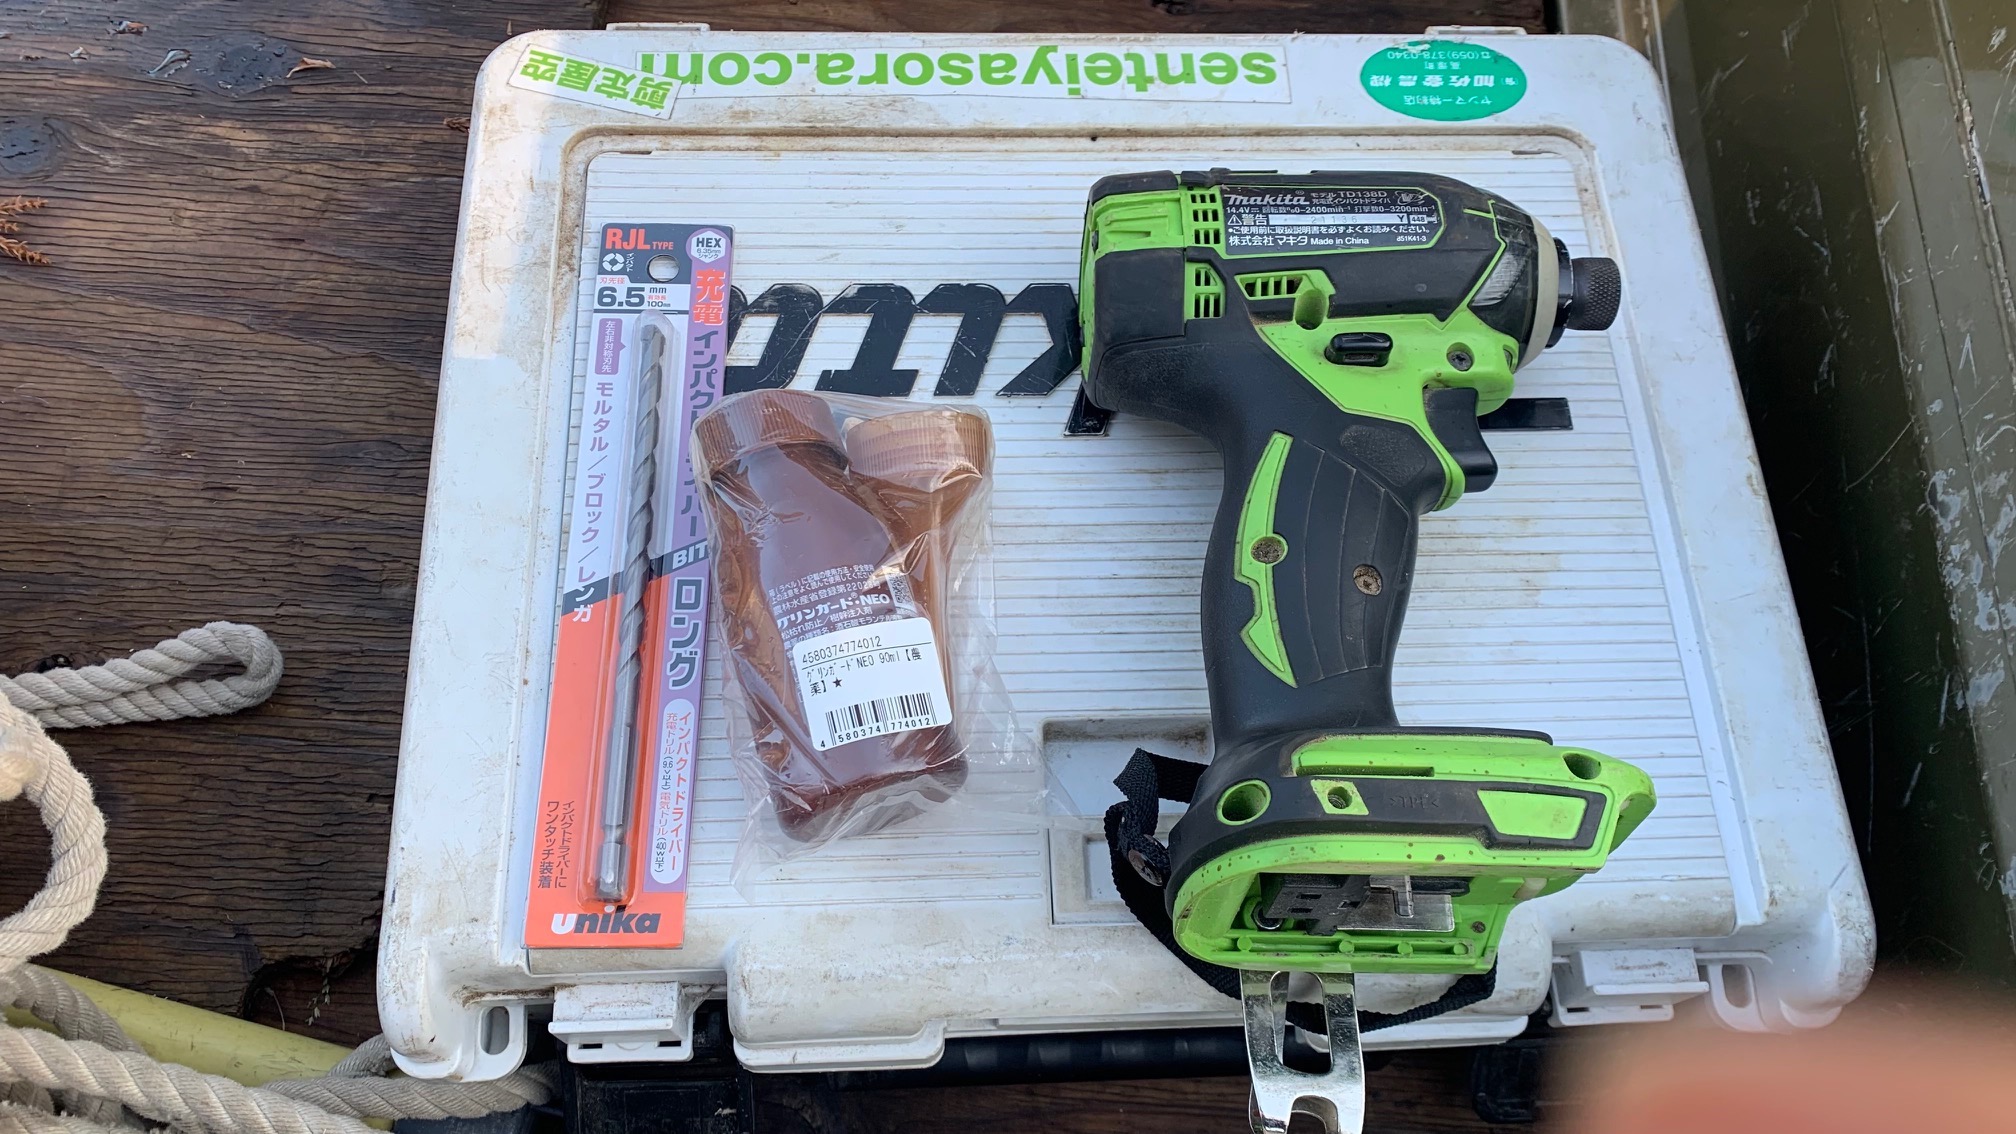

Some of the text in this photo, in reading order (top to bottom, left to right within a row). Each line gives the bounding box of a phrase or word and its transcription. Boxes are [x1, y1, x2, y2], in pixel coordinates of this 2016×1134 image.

[520, 49, 674, 111] 剪定屋空
[641, 45, 1277, 96] senteiyasora.com
[1223, 193, 1310, 206] makita
[1338, 190, 1388, 198] TD138D
[1241, 213, 1268, 226] 警告
[605, 228, 674, 250] RJL TYPE
[695, 236, 722, 248] HEX
[1310, 236, 1370, 246] Made in China
[597, 286, 667, 307] 6.5 mm
[692, 267, 726, 326] 充電
[601, 320, 616, 373] 左右非対称刃先
[671, 540, 708, 570] BIT
[666, 576, 705, 690] ロング
[802, 635, 883, 664] 4580374774012
[820, 716, 931, 749] 4 580374 774012
[668, 711, 692, 871] インパクトドライバー
[537, 801, 560, 889] ワンタッチ装着
[554, 800, 575, 889] インパクトドライバーに
[551, 904, 662, 935] unika
